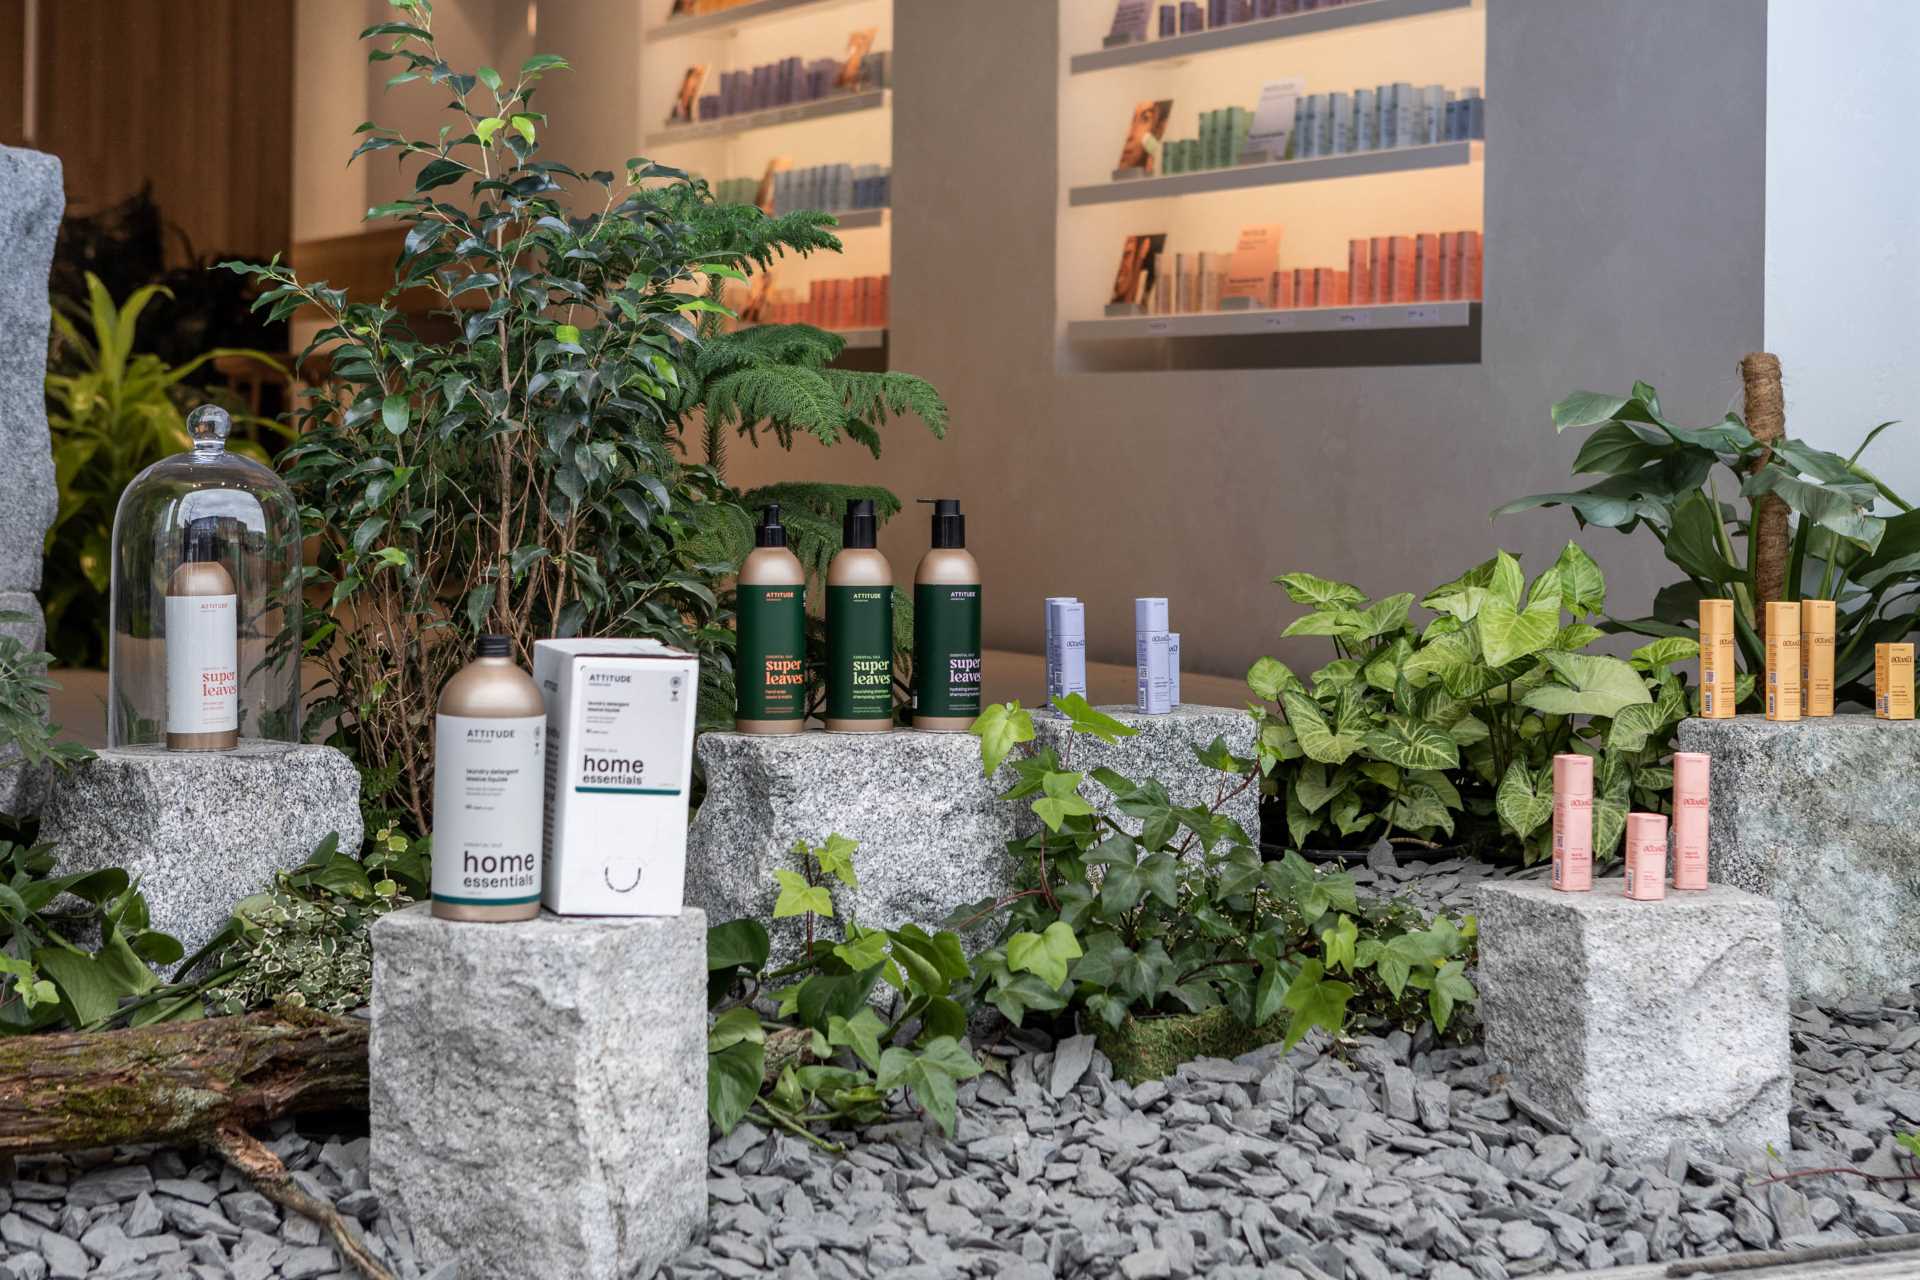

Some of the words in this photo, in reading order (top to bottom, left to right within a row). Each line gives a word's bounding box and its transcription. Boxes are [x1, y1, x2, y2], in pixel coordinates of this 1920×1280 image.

[765, 660, 802, 674] super
[853, 660, 889, 674] super
[950, 658, 981, 672] super
[589, 674, 632, 683] ATTITUDE
[766, 671, 804, 685] leaves
[853, 671, 891, 685] leaves
[203, 683, 238, 696] leaves
[467, 729, 515, 739] ATTITUDE
[583, 754, 645, 774] home
[582, 774, 643, 786] essentials
[464, 850, 535, 873] home
[463, 874, 534, 888] essentials
